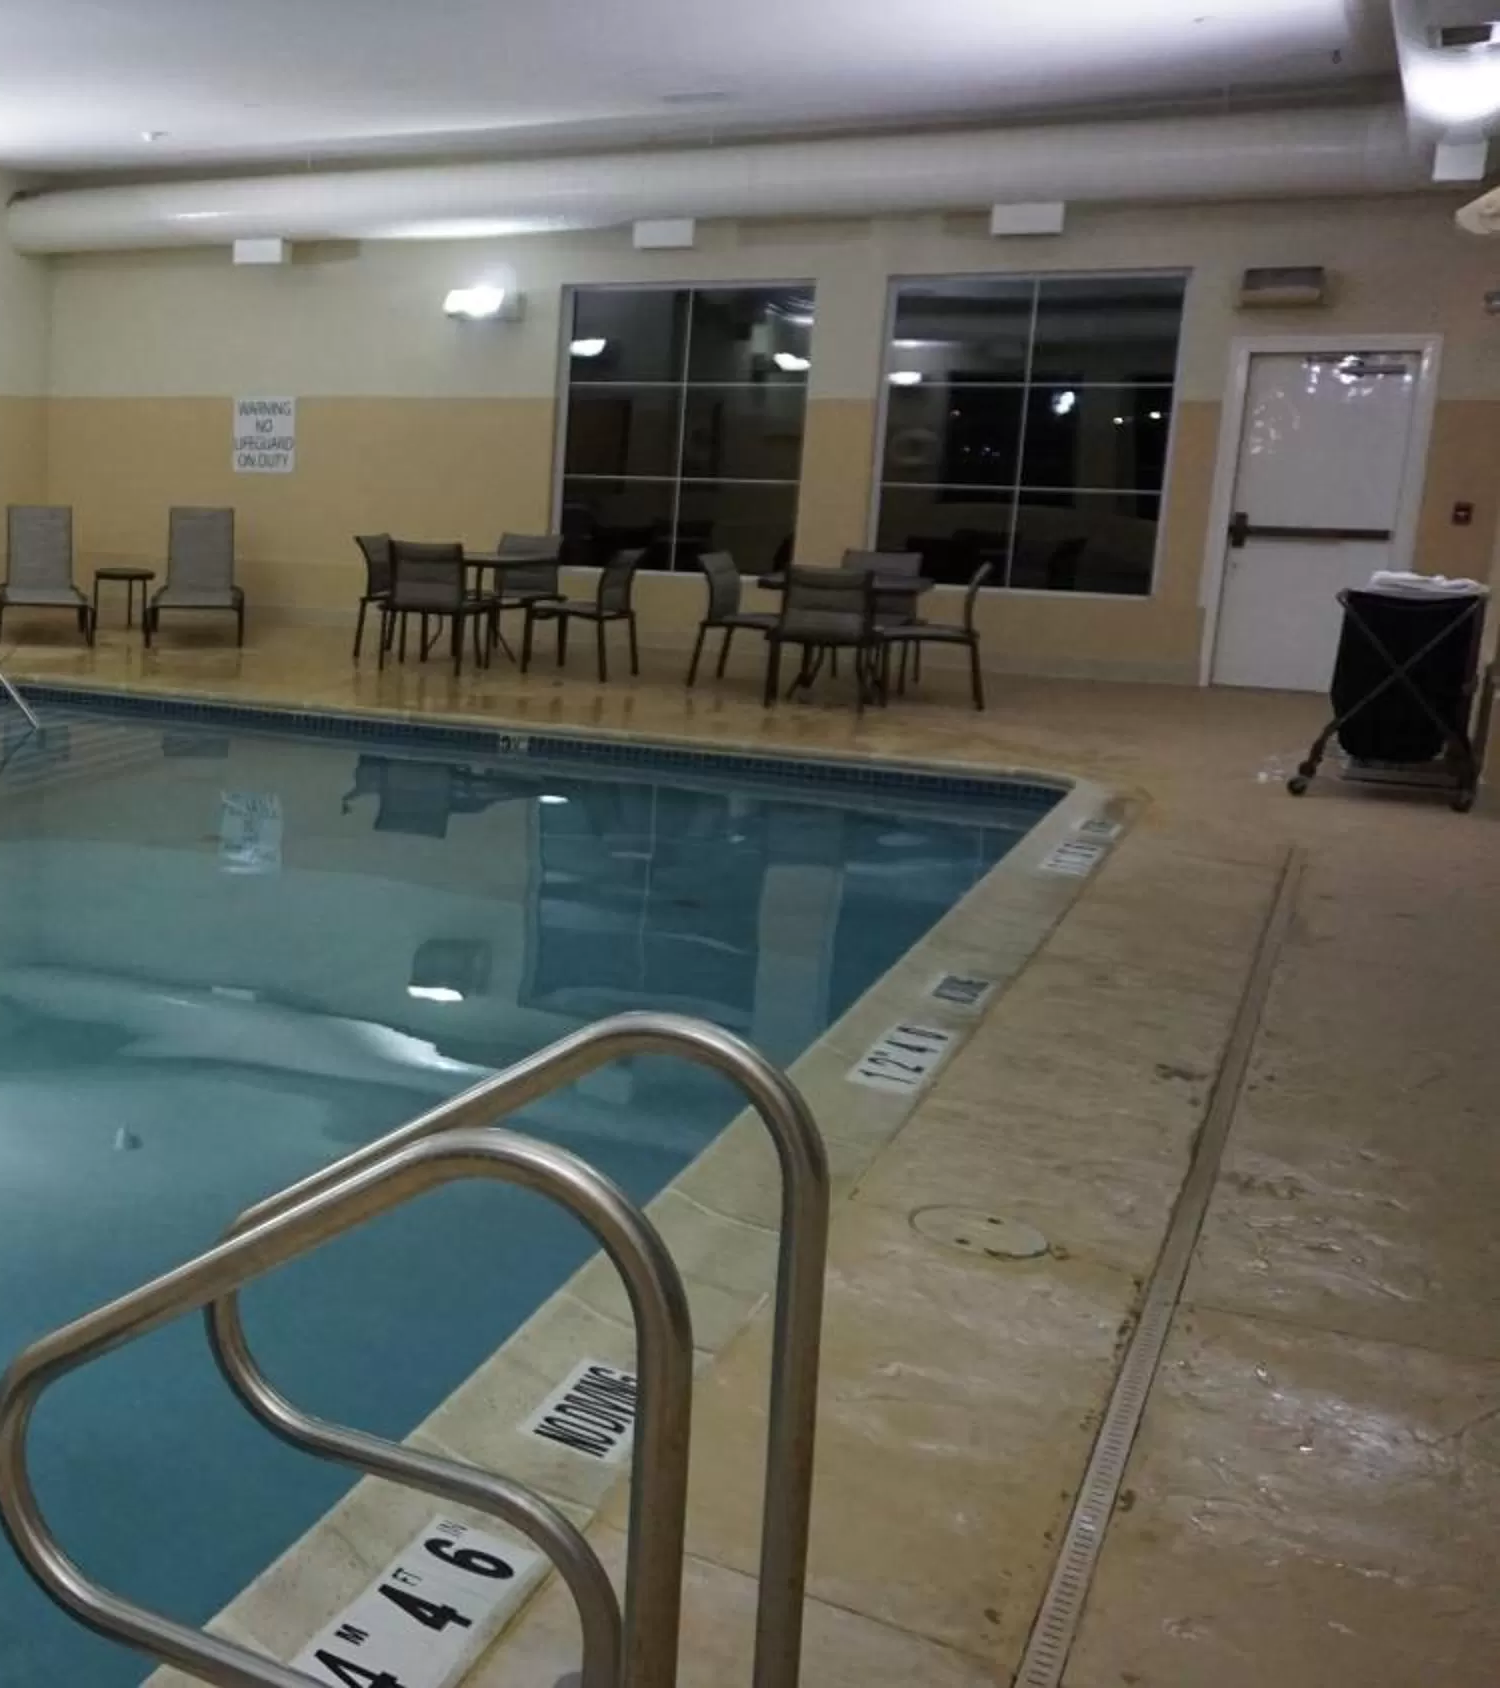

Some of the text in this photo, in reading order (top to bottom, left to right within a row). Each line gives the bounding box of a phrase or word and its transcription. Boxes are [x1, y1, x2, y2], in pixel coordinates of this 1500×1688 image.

[238, 400, 293, 416] WARNING
[255, 418, 273, 433] NO
[236, 436, 296, 450] LIFEGUARD
[237, 453, 289, 468] ON DUTY
[533, 1416, 616, 1458] NO
[423, 1538, 515, 1580] 6
[377, 1583, 473, 1633] 4
[334, 1623, 369, 1647] M
